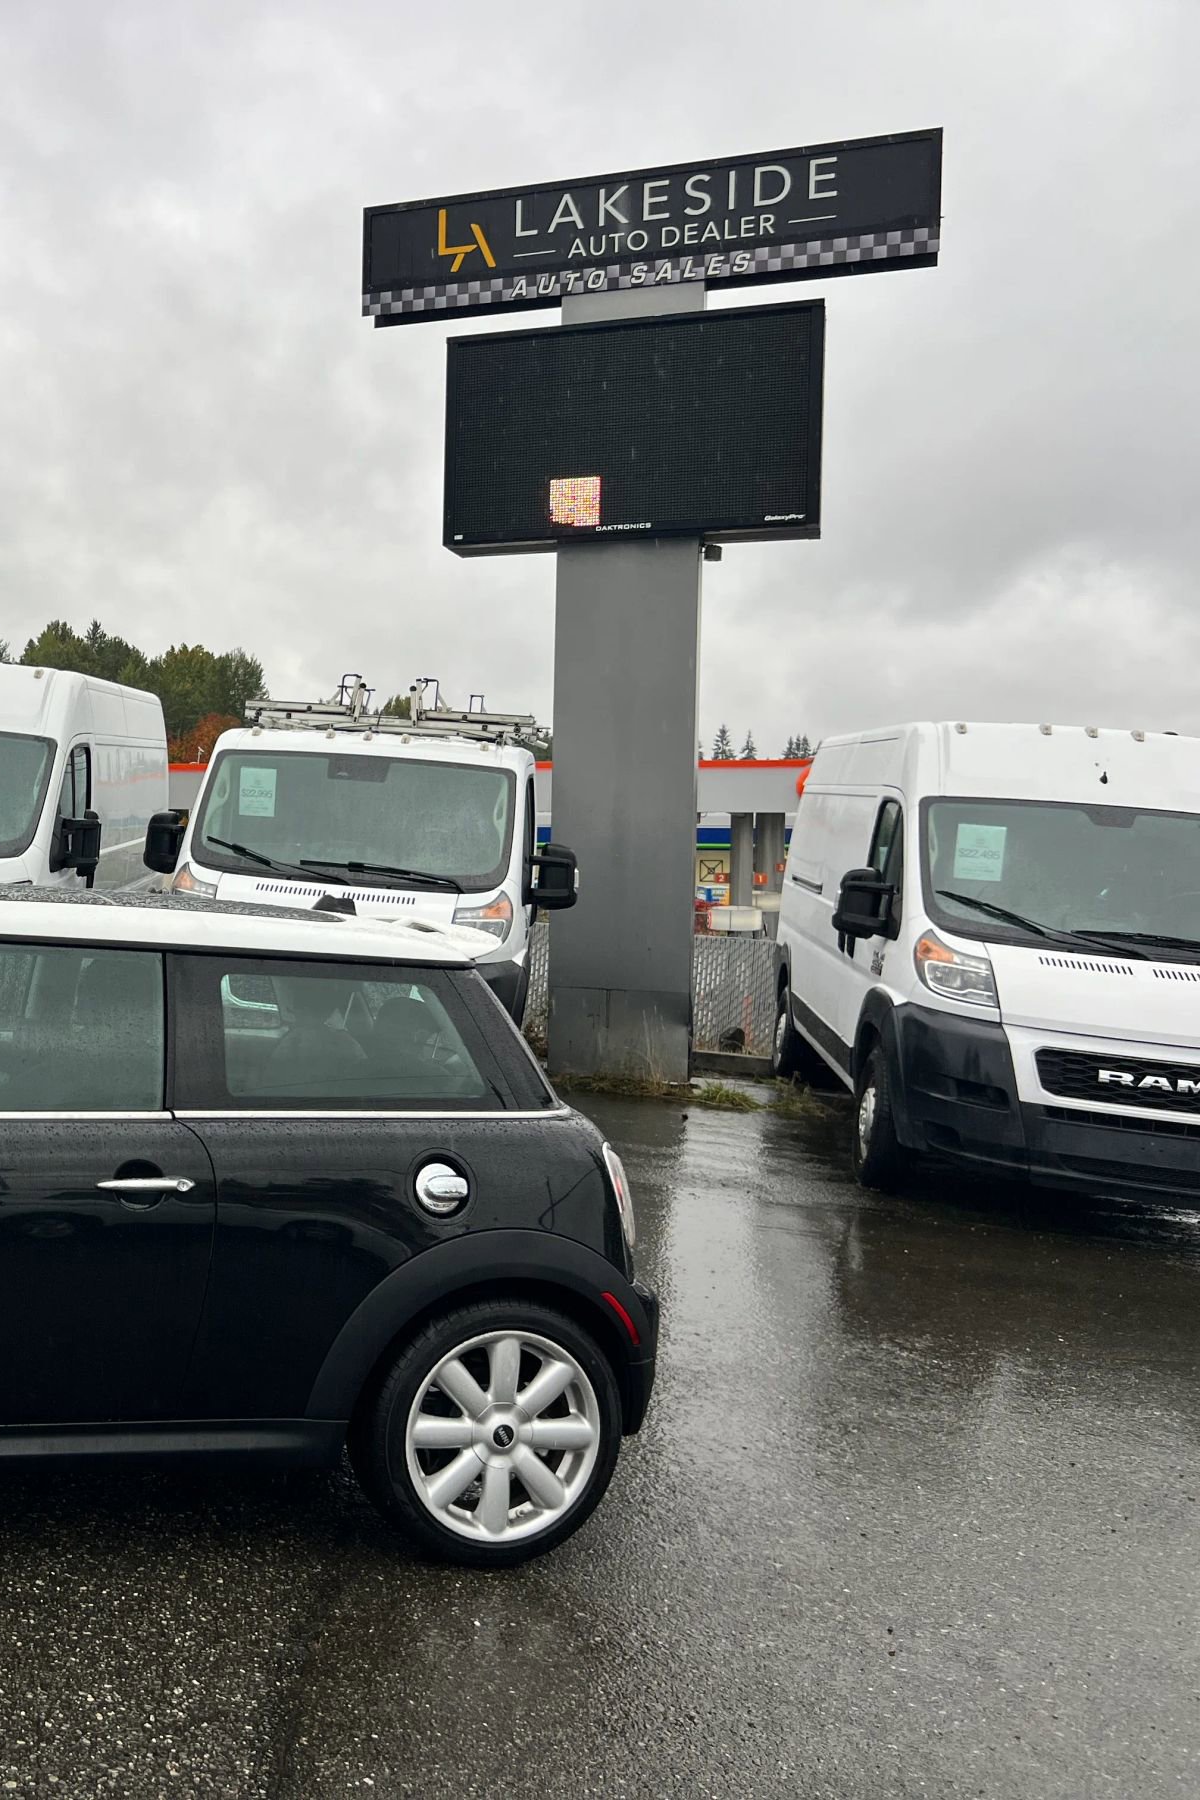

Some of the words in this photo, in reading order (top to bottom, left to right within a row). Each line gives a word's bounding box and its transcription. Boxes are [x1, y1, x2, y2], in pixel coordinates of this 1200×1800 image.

[515, 156, 838, 238] LAKESIDE
[567, 229, 649, 259] AUTO
[660, 213, 776, 248] DEALER
[511, 270, 606, 299] AUTO
[630, 252, 751, 285] SALES
[595, 522, 652, 532] DAKTRONICS
[718, 874, 725, 882] 2
[1097, 1069, 1200, 1094] RAM
